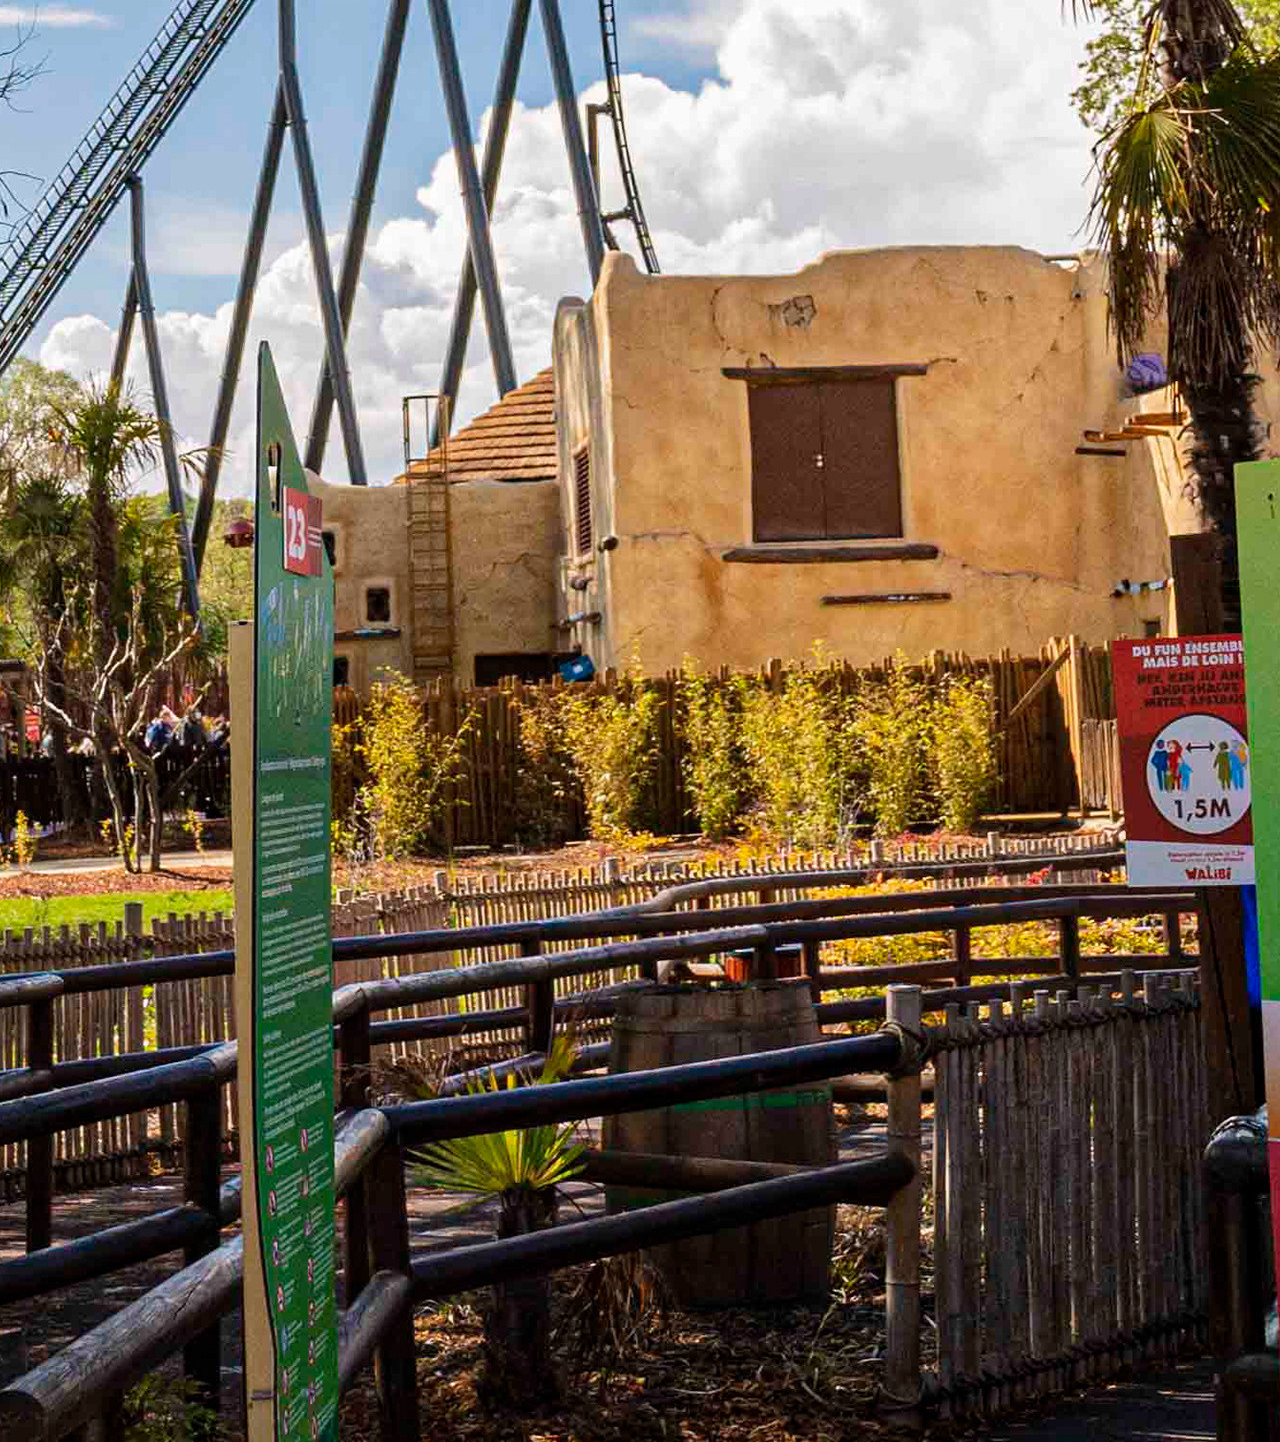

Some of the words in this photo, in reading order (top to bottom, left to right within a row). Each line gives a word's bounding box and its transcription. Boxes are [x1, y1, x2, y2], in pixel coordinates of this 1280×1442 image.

[287, 504, 307, 561] 23
[1132, 645, 1151, 657] DU
[1154, 644, 1181, 656] FUN
[1185, 640, 1244, 654] ENSEMBL
[1182, 655, 1199, 666] DE
[1175, 798, 1231, 822] 1,5M
